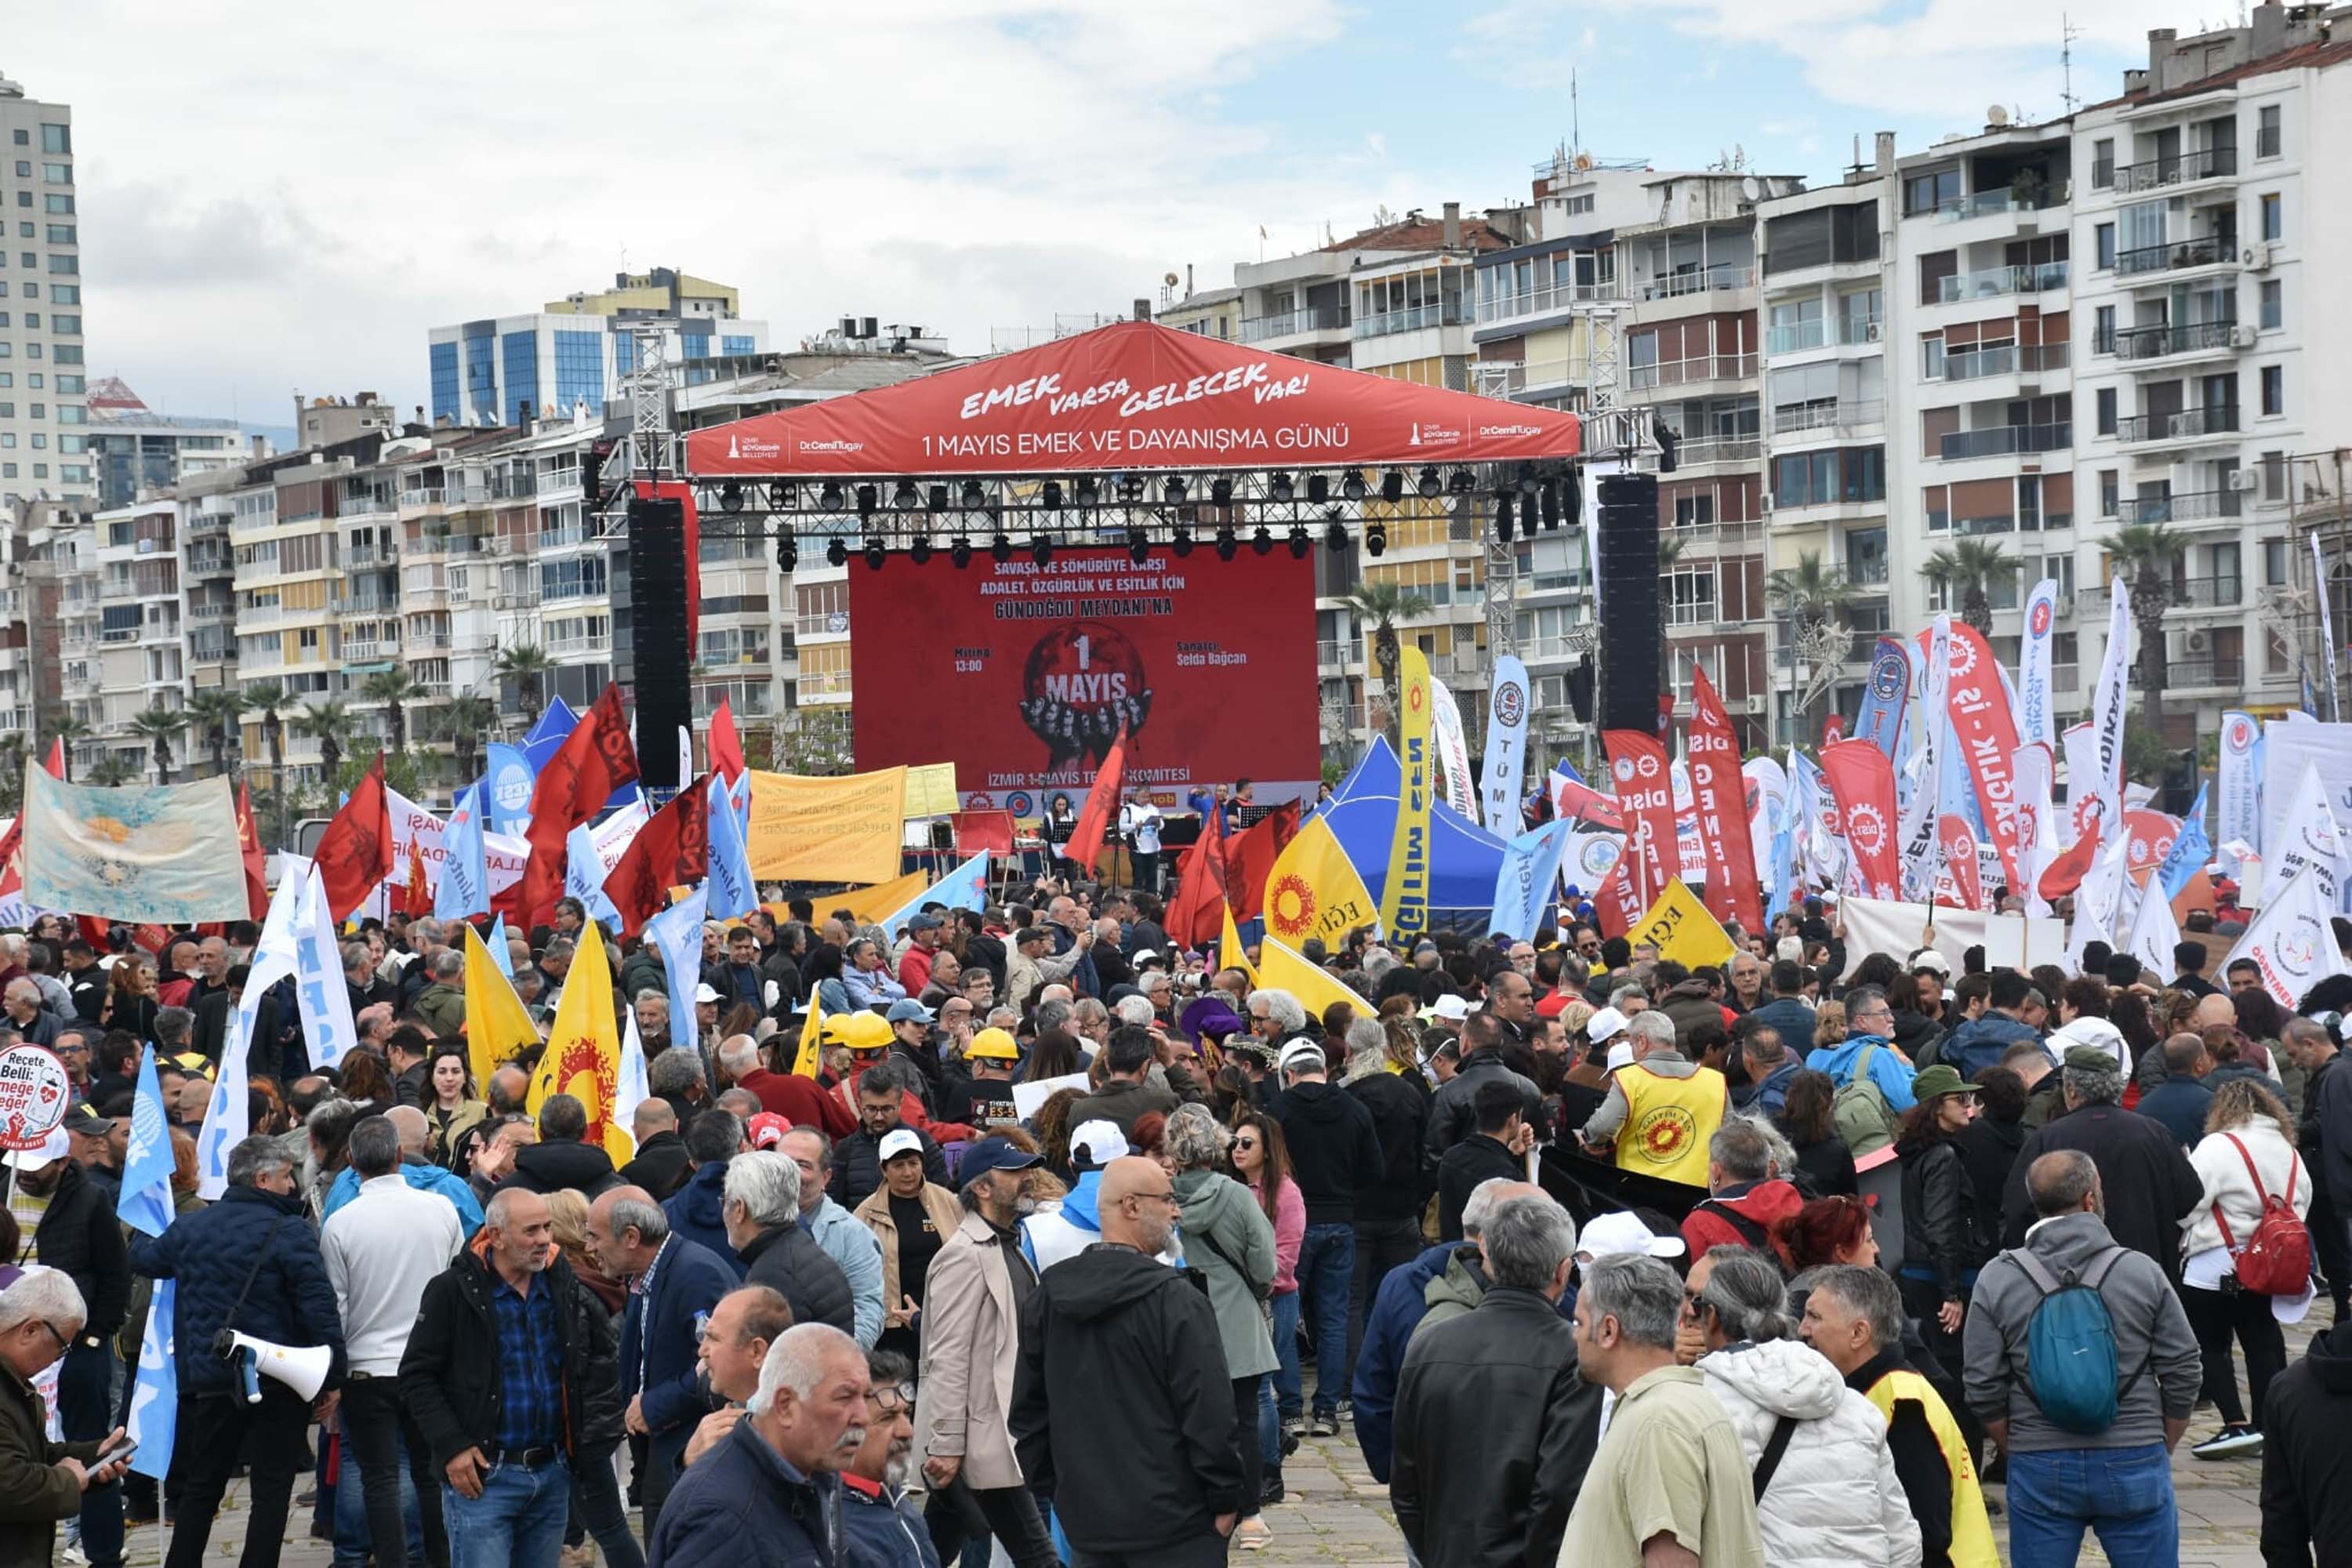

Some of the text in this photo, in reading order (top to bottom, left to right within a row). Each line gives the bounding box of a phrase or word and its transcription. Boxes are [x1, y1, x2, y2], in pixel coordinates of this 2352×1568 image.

[960, 362, 1309, 419] EMEK VARSA GELECEK VAR!
[922, 423, 1349, 457] 1 MAYIS EMEK VE DAYANIŞMA GÜNÜ
[994, 562, 1040, 577] SAVAŞA
[1061, 557, 1127, 574] SÖMÜRÜYE
[1032, 577, 1095, 593] ÖZGÜRLÜK
[1098, 578, 1112, 592] VE
[1116, 575, 1159, 594] EŞİTLİK
[1162, 574, 1185, 593] İÇİN
[994, 596, 1174, 619] GÜNDOĞDU MEYDANI'NA
[1073, 634, 1091, 670] 1
[1177, 651, 1247, 666] Selda Bağcan
[955, 659, 983, 673] 13:00
[1045, 672, 1127, 703] MAYIS
[988, 769, 1025, 787] İZMİR
[1129, 766, 1191, 782] KOMİTESİ
[9, 1052, 45, 1067] Reçete
[1, 1065, 34, 1081] Belli:
[989, 1107, 1015, 1117] ES-5
